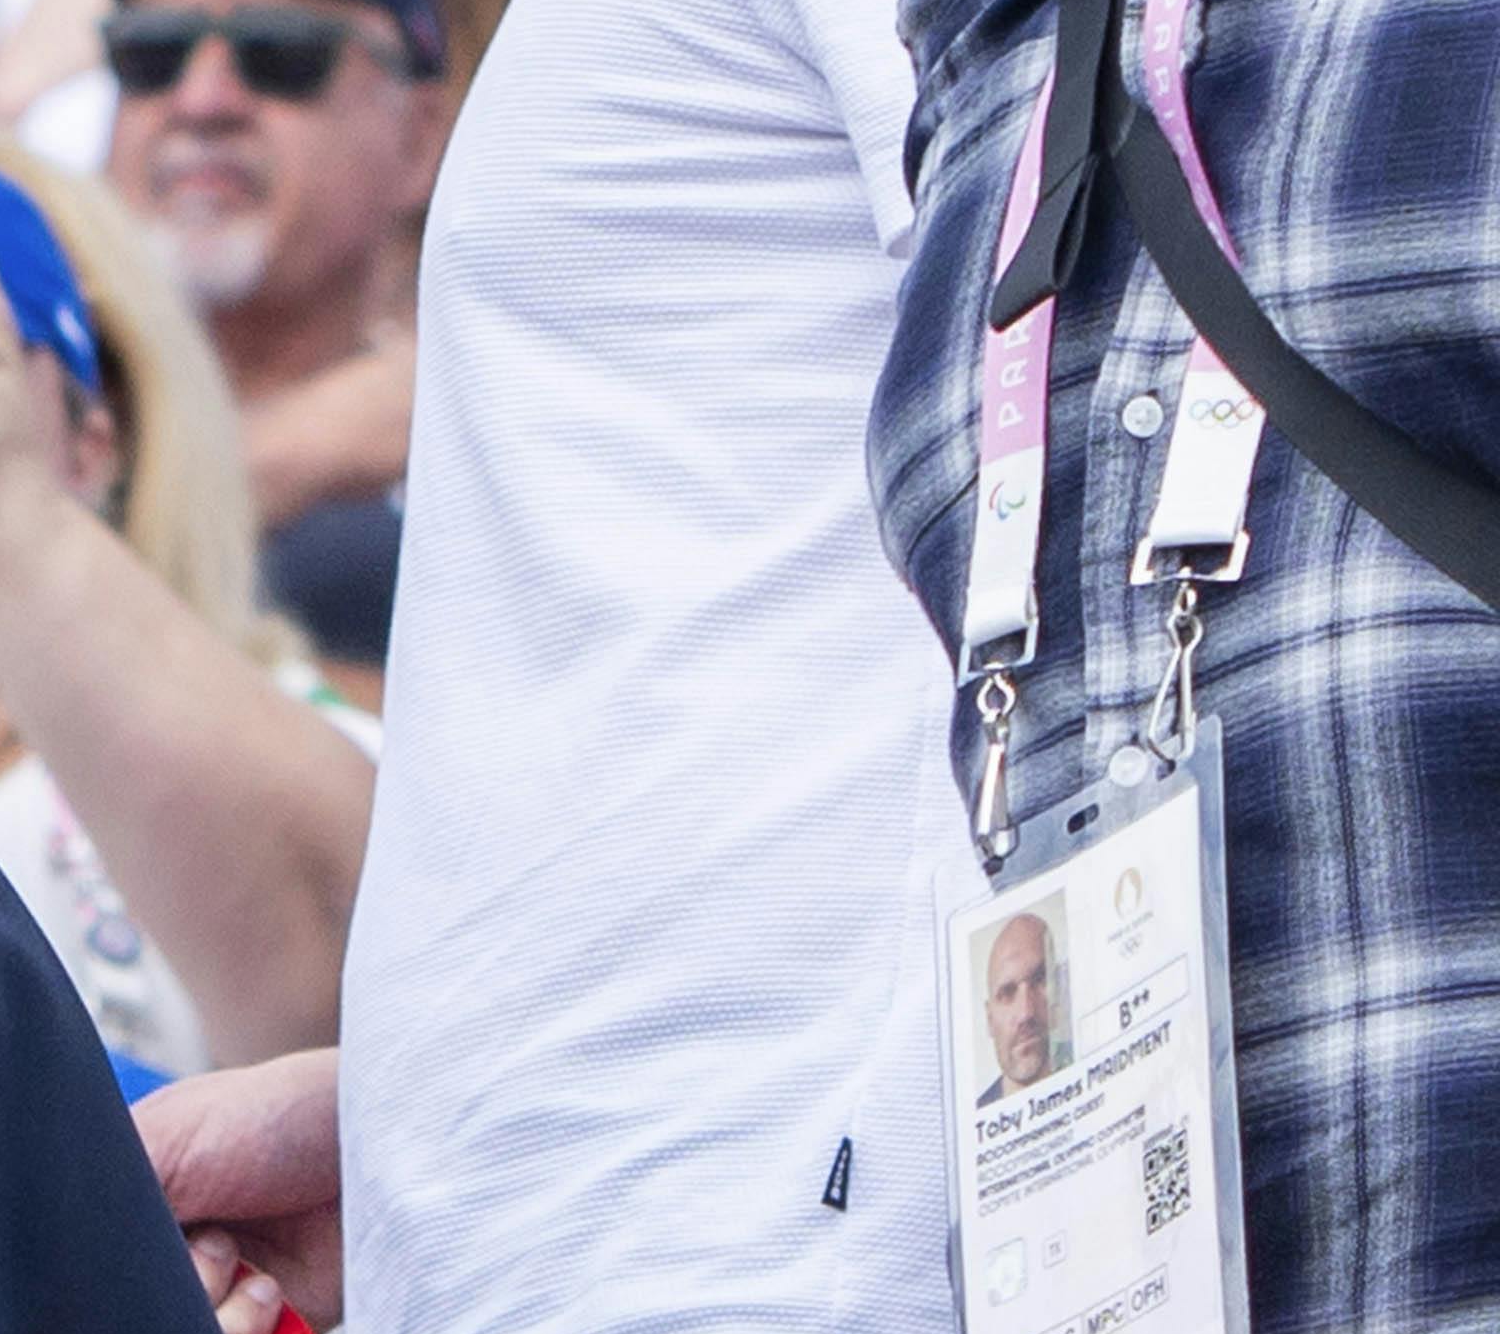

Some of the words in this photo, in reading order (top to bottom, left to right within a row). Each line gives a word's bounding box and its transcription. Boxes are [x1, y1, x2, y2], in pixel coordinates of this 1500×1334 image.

[975, 1108, 1024, 1145] Toby
[1027, 1078, 1083, 1121] James
[1086, 1019, 1172, 1091] MAIDMENT
[1130, 1275, 1166, 1312] OFH
